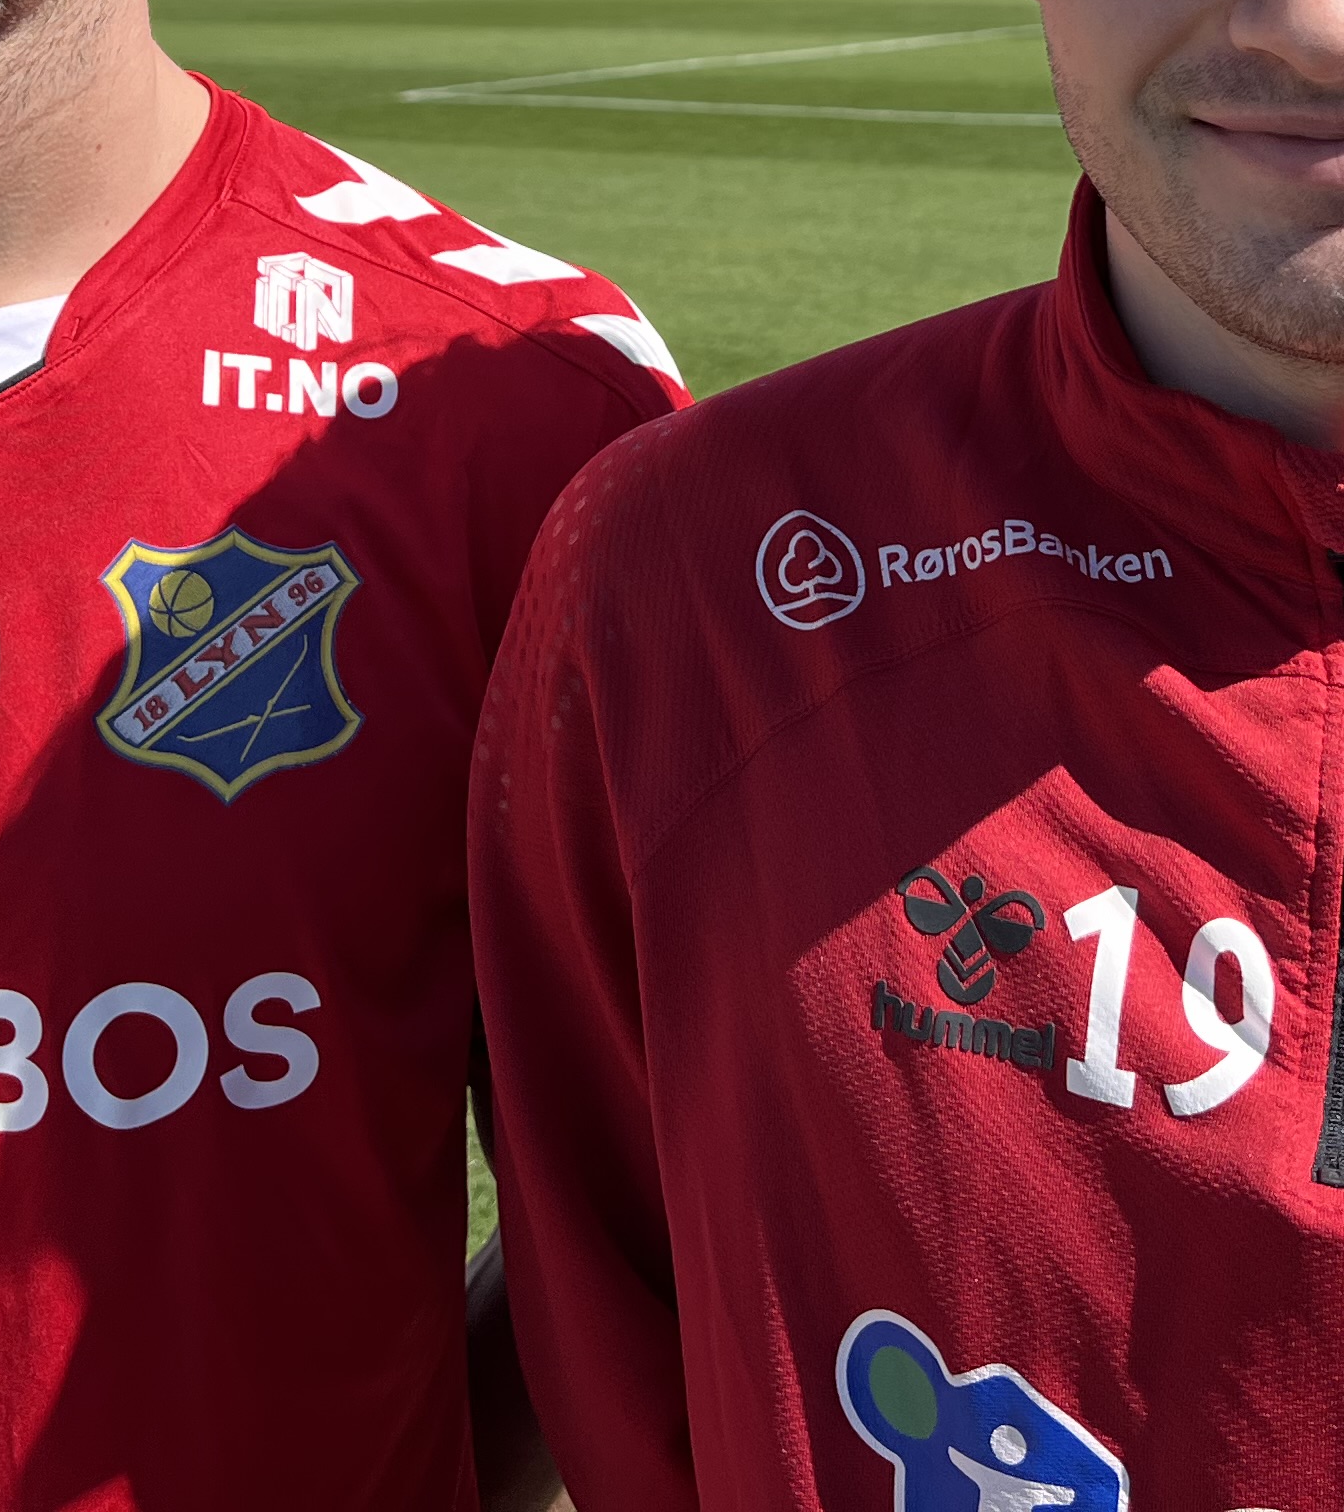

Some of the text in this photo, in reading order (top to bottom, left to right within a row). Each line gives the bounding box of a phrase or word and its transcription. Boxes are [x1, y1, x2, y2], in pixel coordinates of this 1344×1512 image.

[202, 349, 399, 419] IT.NO
[878, 519, 1173, 587] RørosBanken
[132, 571, 326, 732] 18 LYN 96
[872, 979, 1055, 1070] hummel
[1063, 885, 1275, 1117] 19
